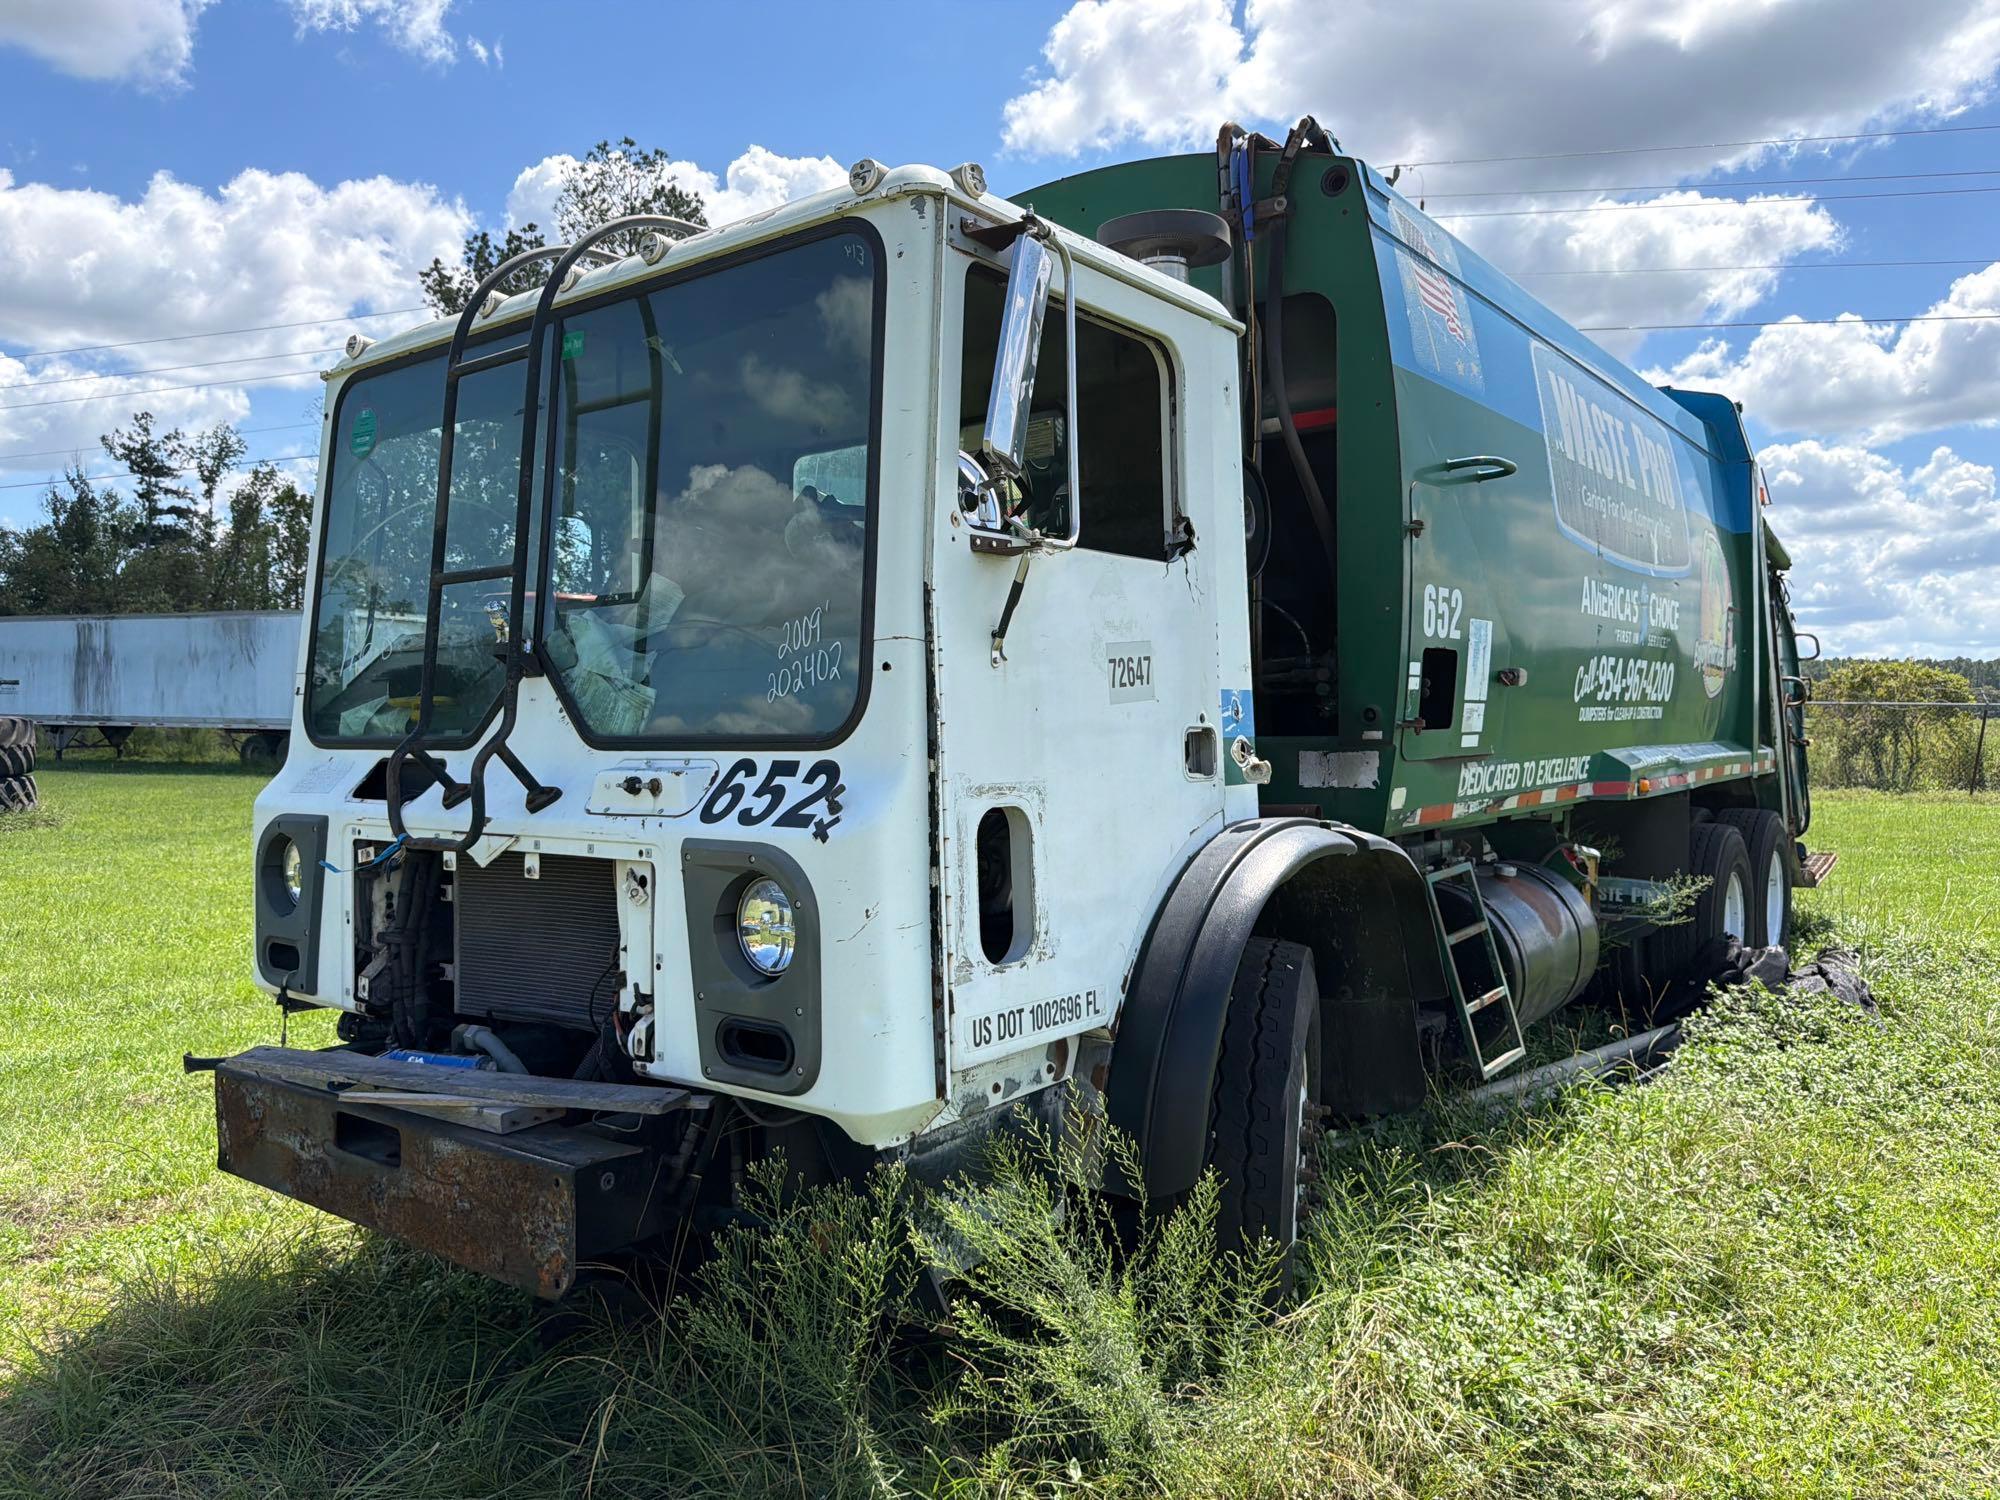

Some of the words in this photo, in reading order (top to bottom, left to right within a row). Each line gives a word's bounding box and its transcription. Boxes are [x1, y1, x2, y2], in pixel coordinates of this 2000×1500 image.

[1547, 369, 1637, 491] WASTE
[1630, 420, 1675, 511] PRO
[1581, 485, 1607, 520] Caring
[1607, 495, 1620, 519] For
[1423, 583, 1463, 640] 652
[1581, 575, 1639, 625] AMERICA'S
[1649, 592, 1680, 631] CHOICE
[767, 641, 842, 704] 202402
[1108, 655, 1151, 688] 72647
[1597, 655, 1675, 702] 954-967-4200
[1578, 706, 1607, 722] DUMPSTERS
[1606, 705, 1615, 721] for
[699, 757, 841, 829] 652
[1457, 761, 1522, 797] DEDICATED
[1521, 760, 1537, 788] TO
[1535, 755, 1591, 786] EXCELLENCE
[1598, 886, 1624, 903] STE
[972, 1015, 992, 1048] US
[997, 1007, 1025, 1041] DOT
[1029, 993, 1082, 1032] 1002696
[1085, 989, 1101, 1017] FL
